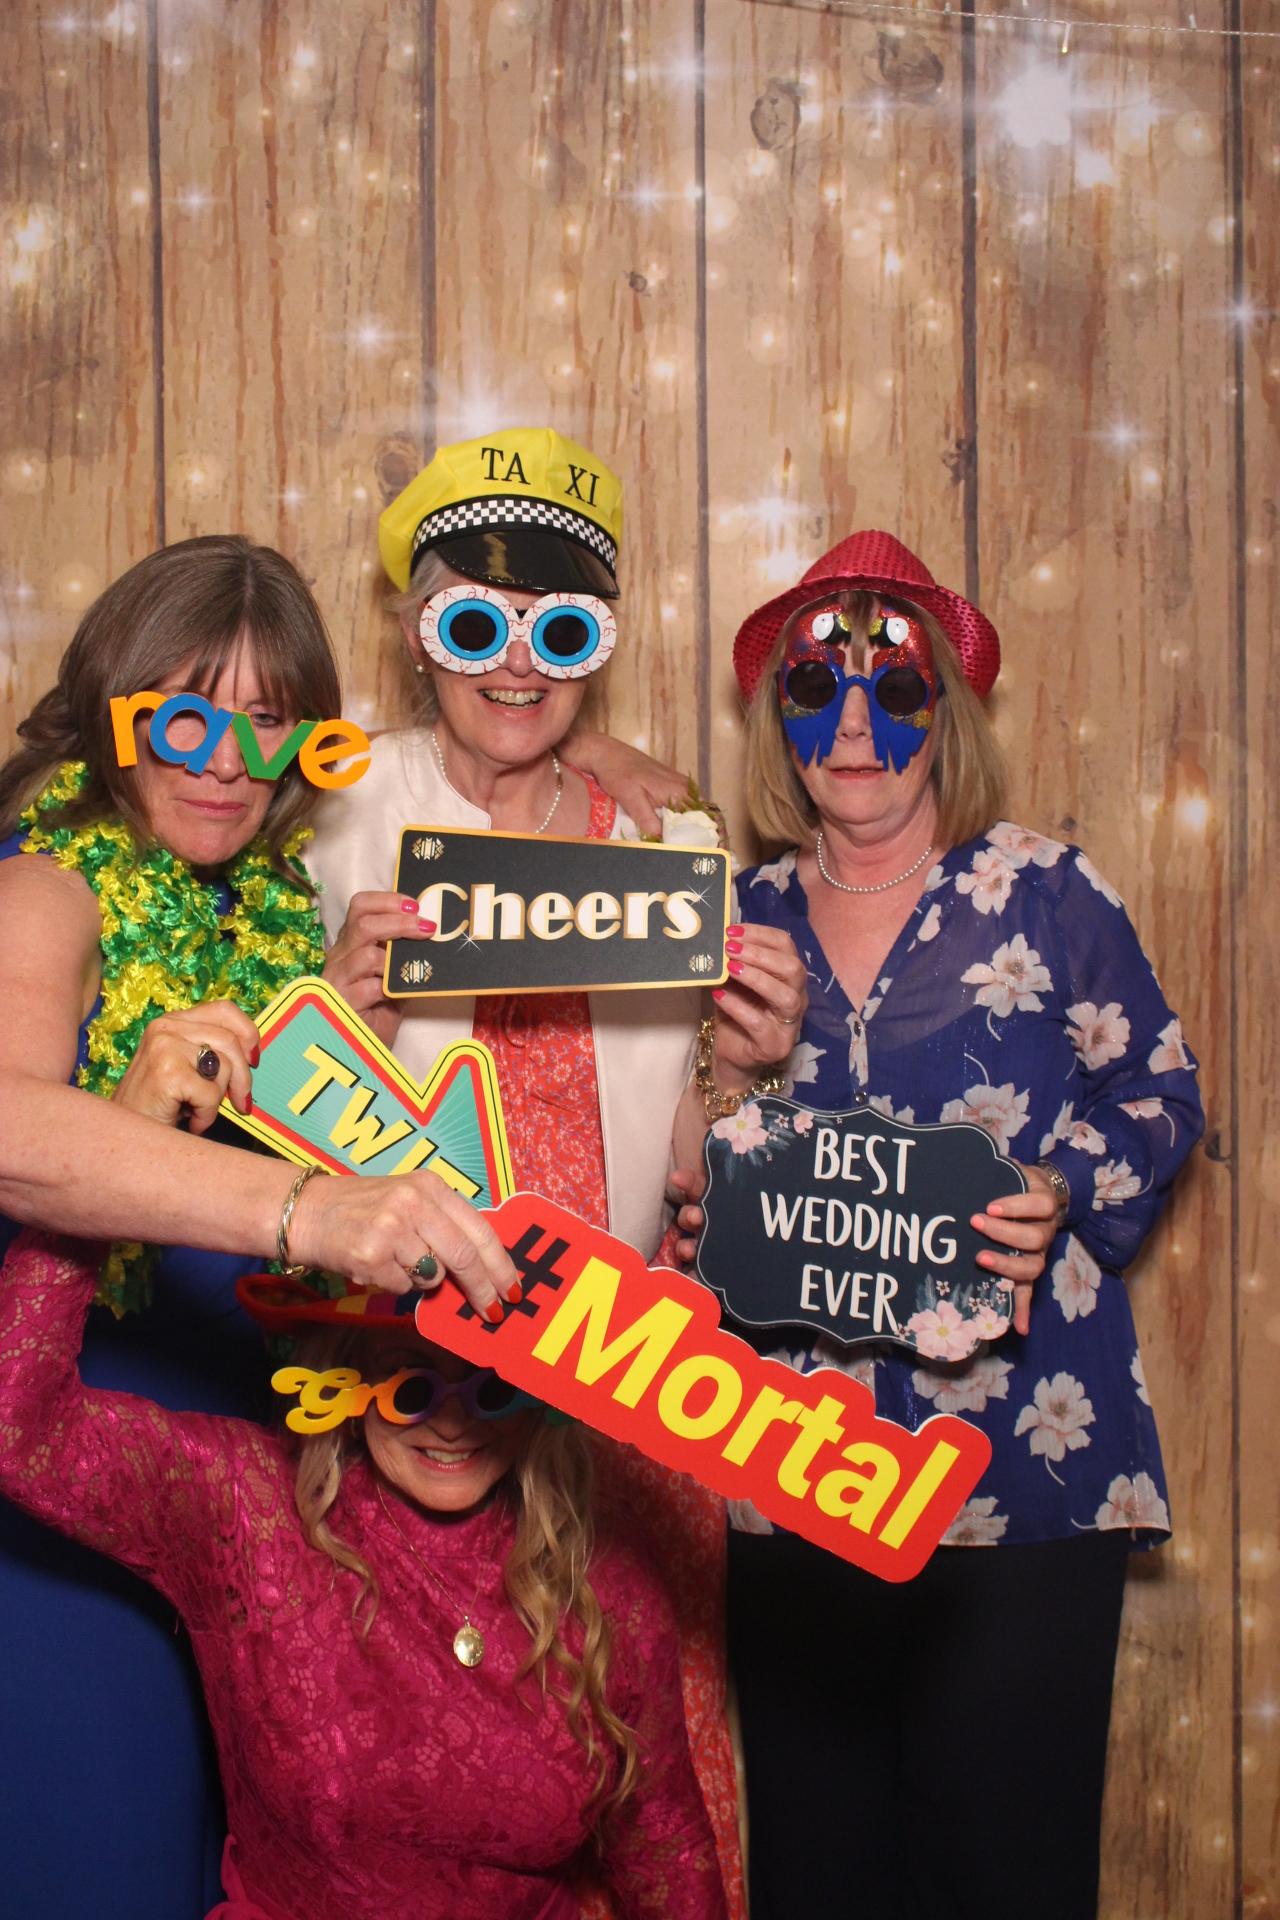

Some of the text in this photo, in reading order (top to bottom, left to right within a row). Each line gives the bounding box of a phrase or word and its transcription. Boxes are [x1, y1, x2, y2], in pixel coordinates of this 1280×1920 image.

[109, 691, 372, 790] rave
[416, 882, 703, 943] Cheers
[814, 1127, 917, 1196] BEST
[760, 1191, 958, 1265] WEDDING
[800, 1263, 899, 1334] EVER
